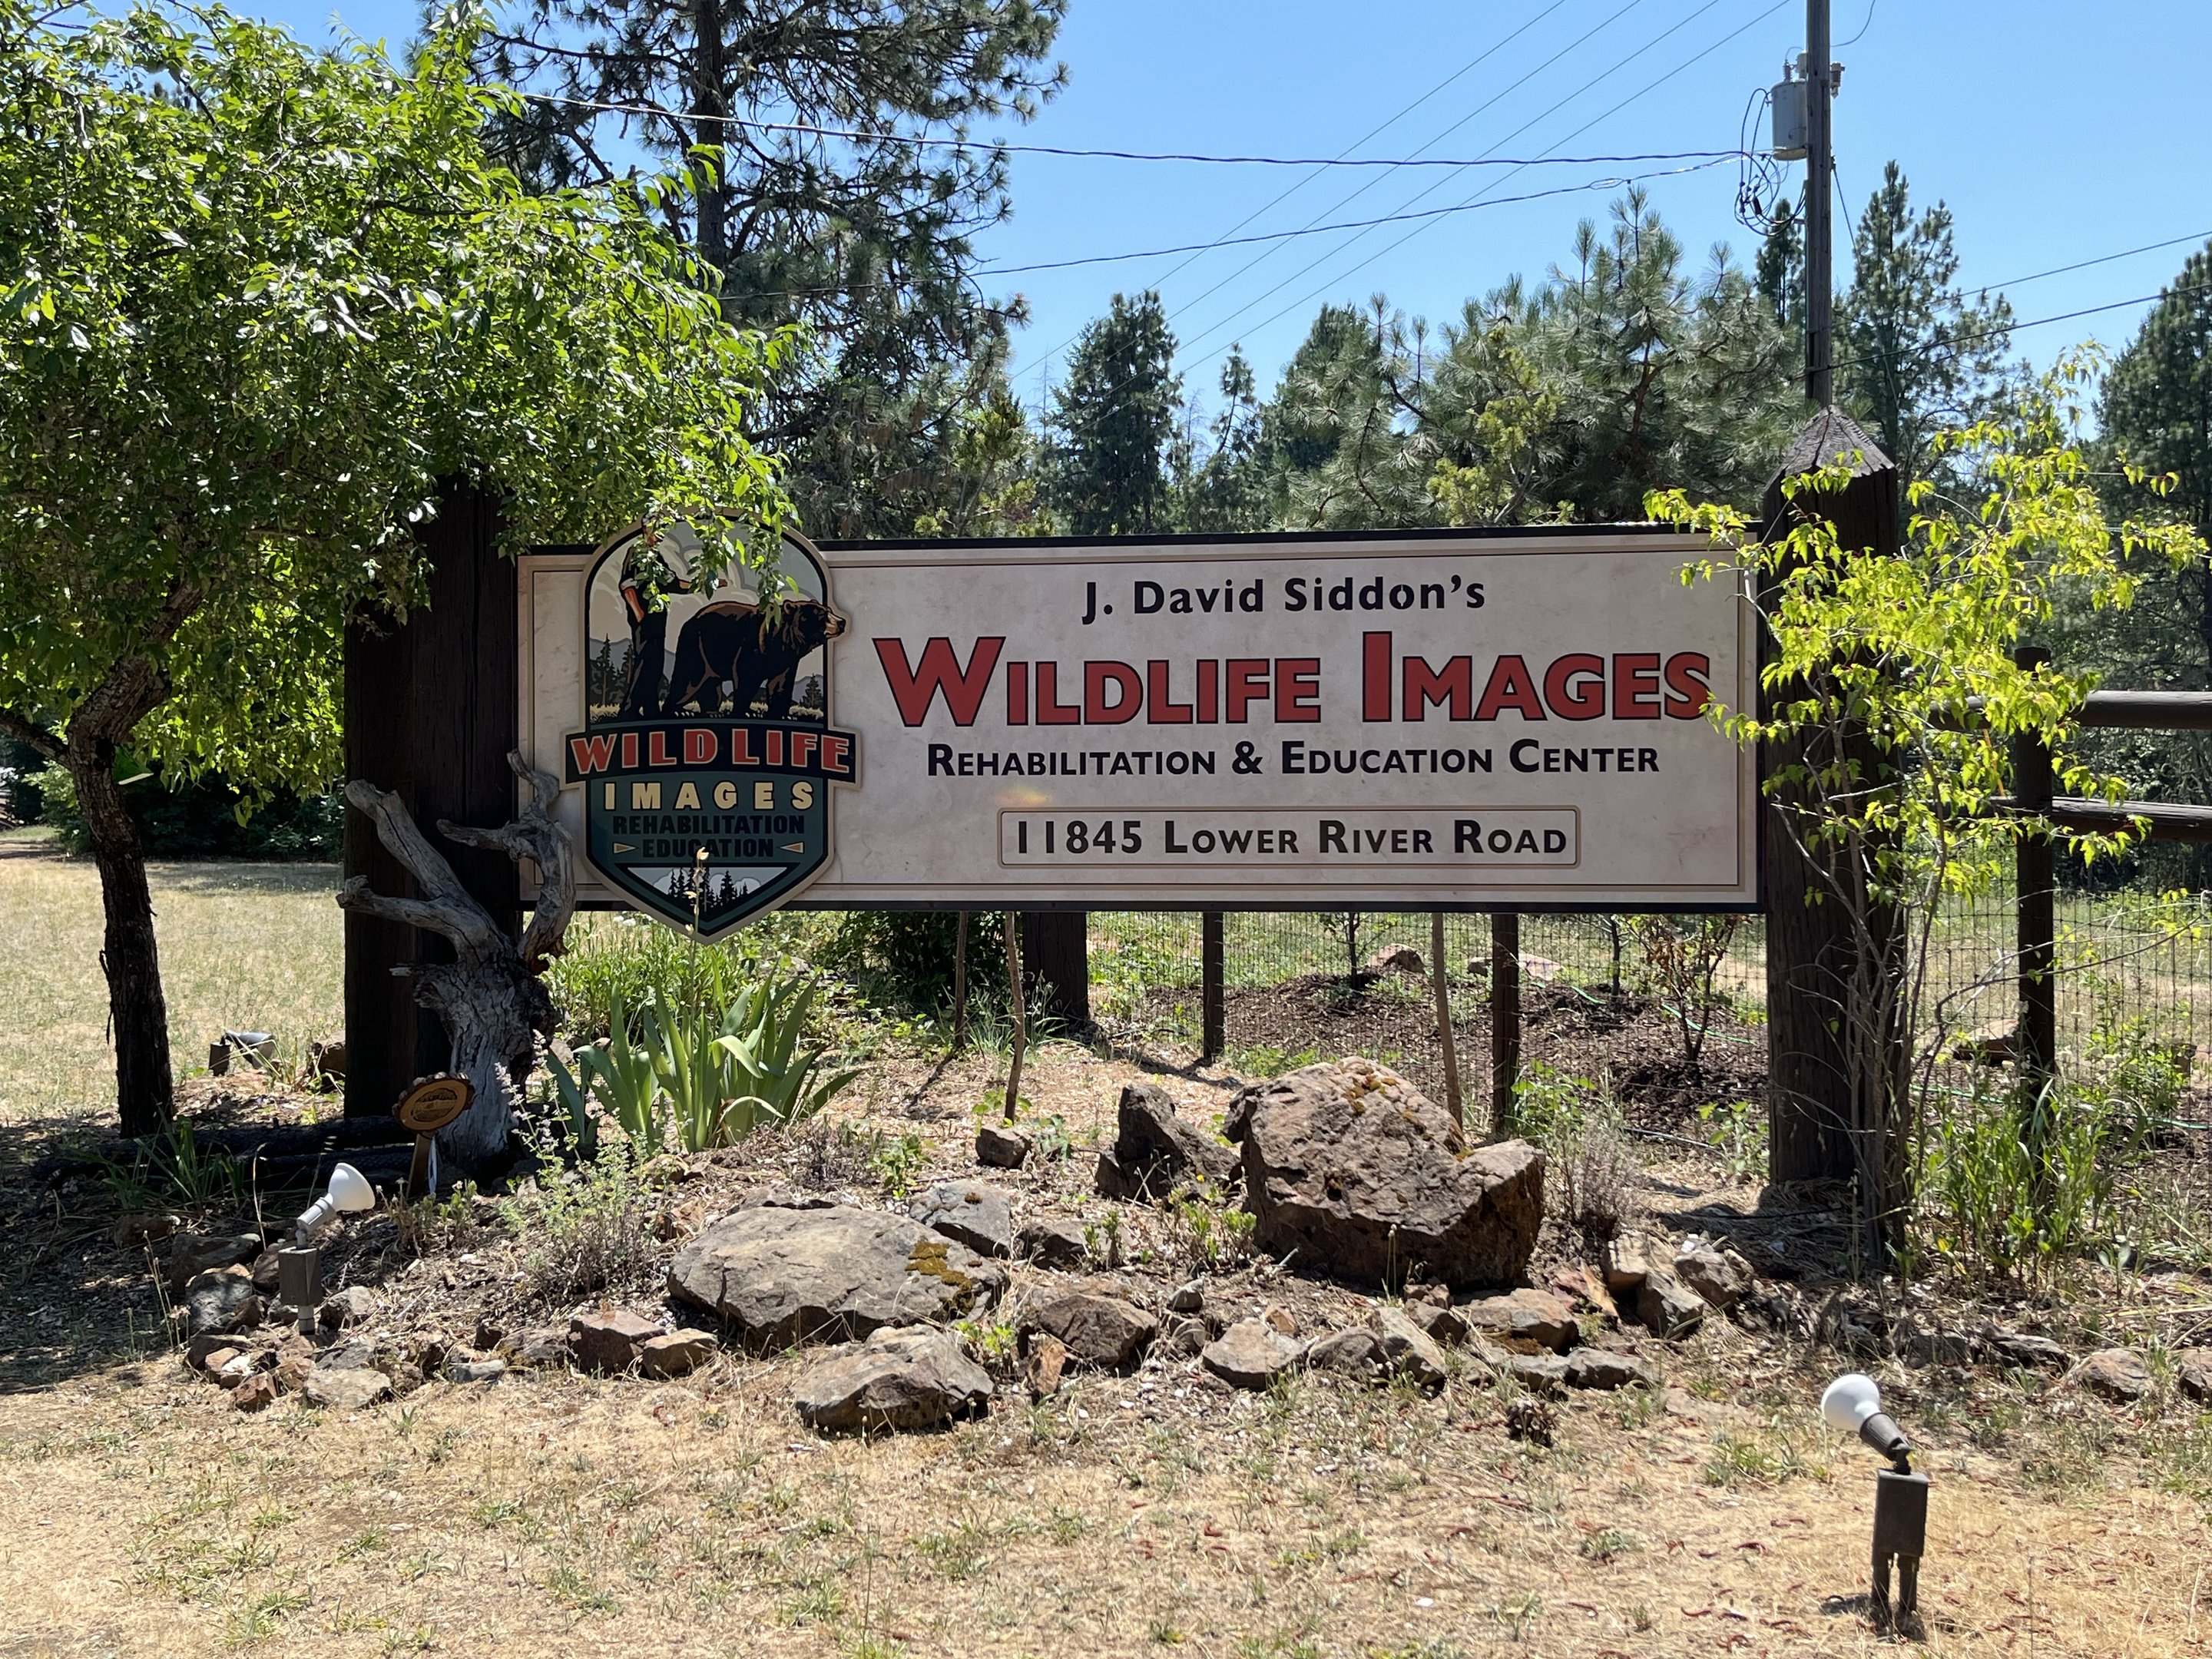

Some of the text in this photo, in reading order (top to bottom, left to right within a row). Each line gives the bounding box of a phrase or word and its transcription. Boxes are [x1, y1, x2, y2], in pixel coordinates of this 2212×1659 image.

[1081, 575, 1485, 625] J. David Siddon's
[571, 728, 849, 774] WILDLIFE
[1232, 740, 1263, 774] &
[604, 780, 815, 810] IMAGES
[613, 814, 805, 834] REHABILITATION
[1018, 820, 1143, 854] 11845
[642, 838, 774, 858] EDUCATION
